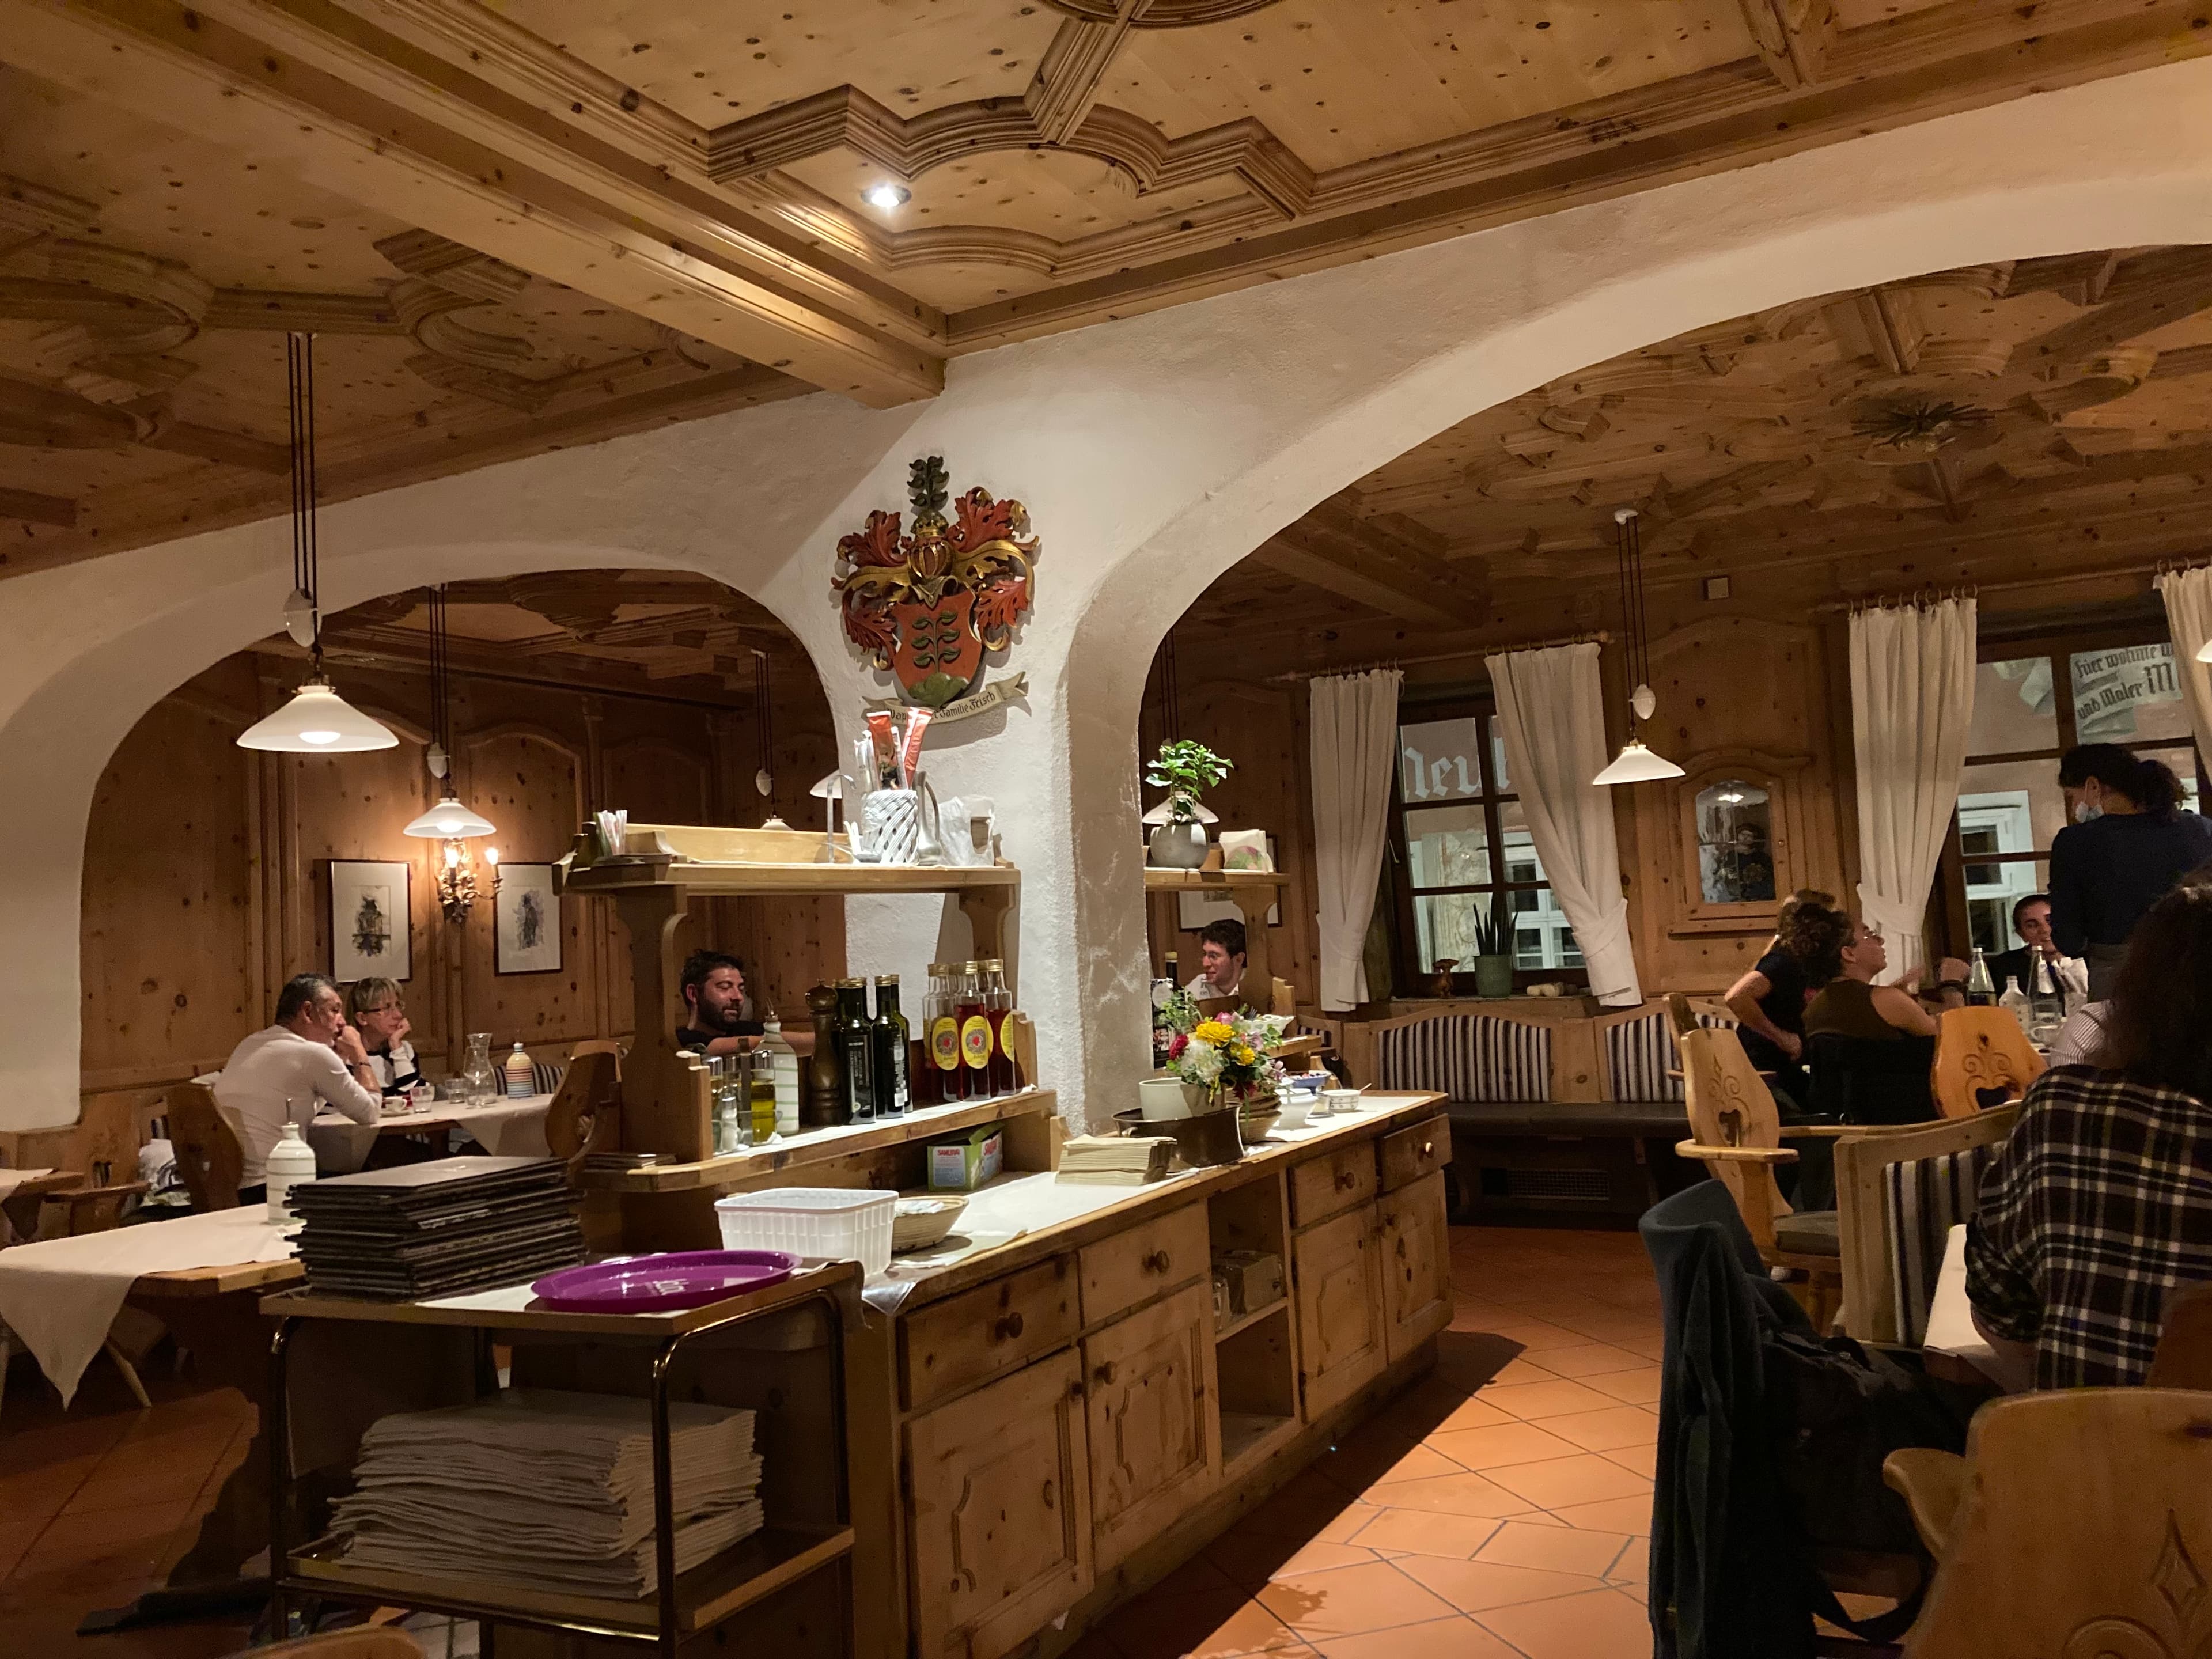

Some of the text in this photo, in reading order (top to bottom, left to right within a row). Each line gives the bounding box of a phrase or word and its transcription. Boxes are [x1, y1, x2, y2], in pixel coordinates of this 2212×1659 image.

[2105, 646, 2157, 668] wohnte
[940, 704, 969, 718] Familie
[969, 691, 995, 710] Frisch
